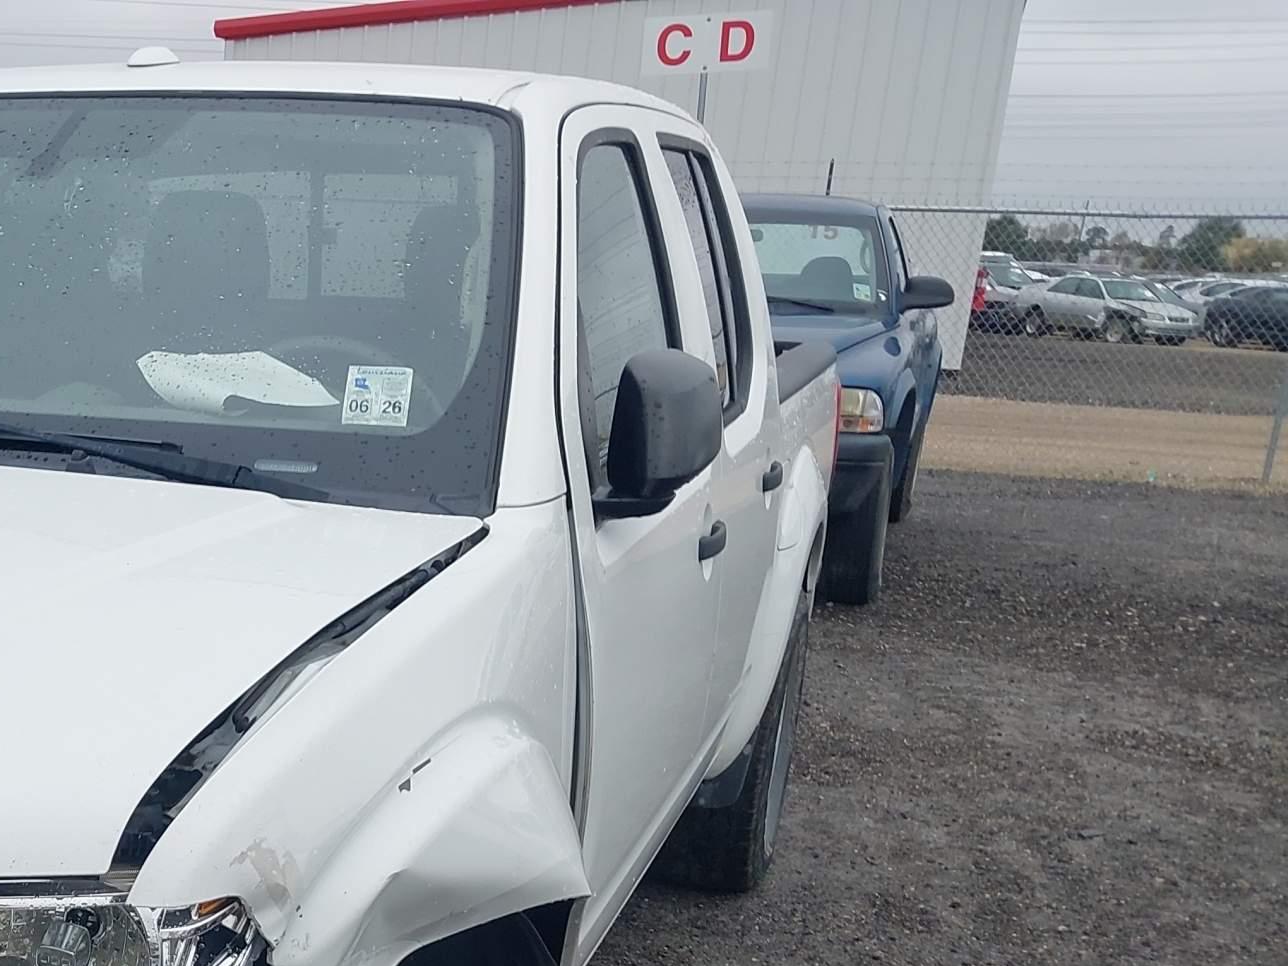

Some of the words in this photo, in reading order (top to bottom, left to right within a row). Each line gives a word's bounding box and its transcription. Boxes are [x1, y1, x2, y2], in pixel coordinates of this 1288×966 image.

[656, 23, 693, 66] C
[719, 20, 755, 62] D
[349, 399, 369, 414] 06
[382, 400, 402, 415] 26
